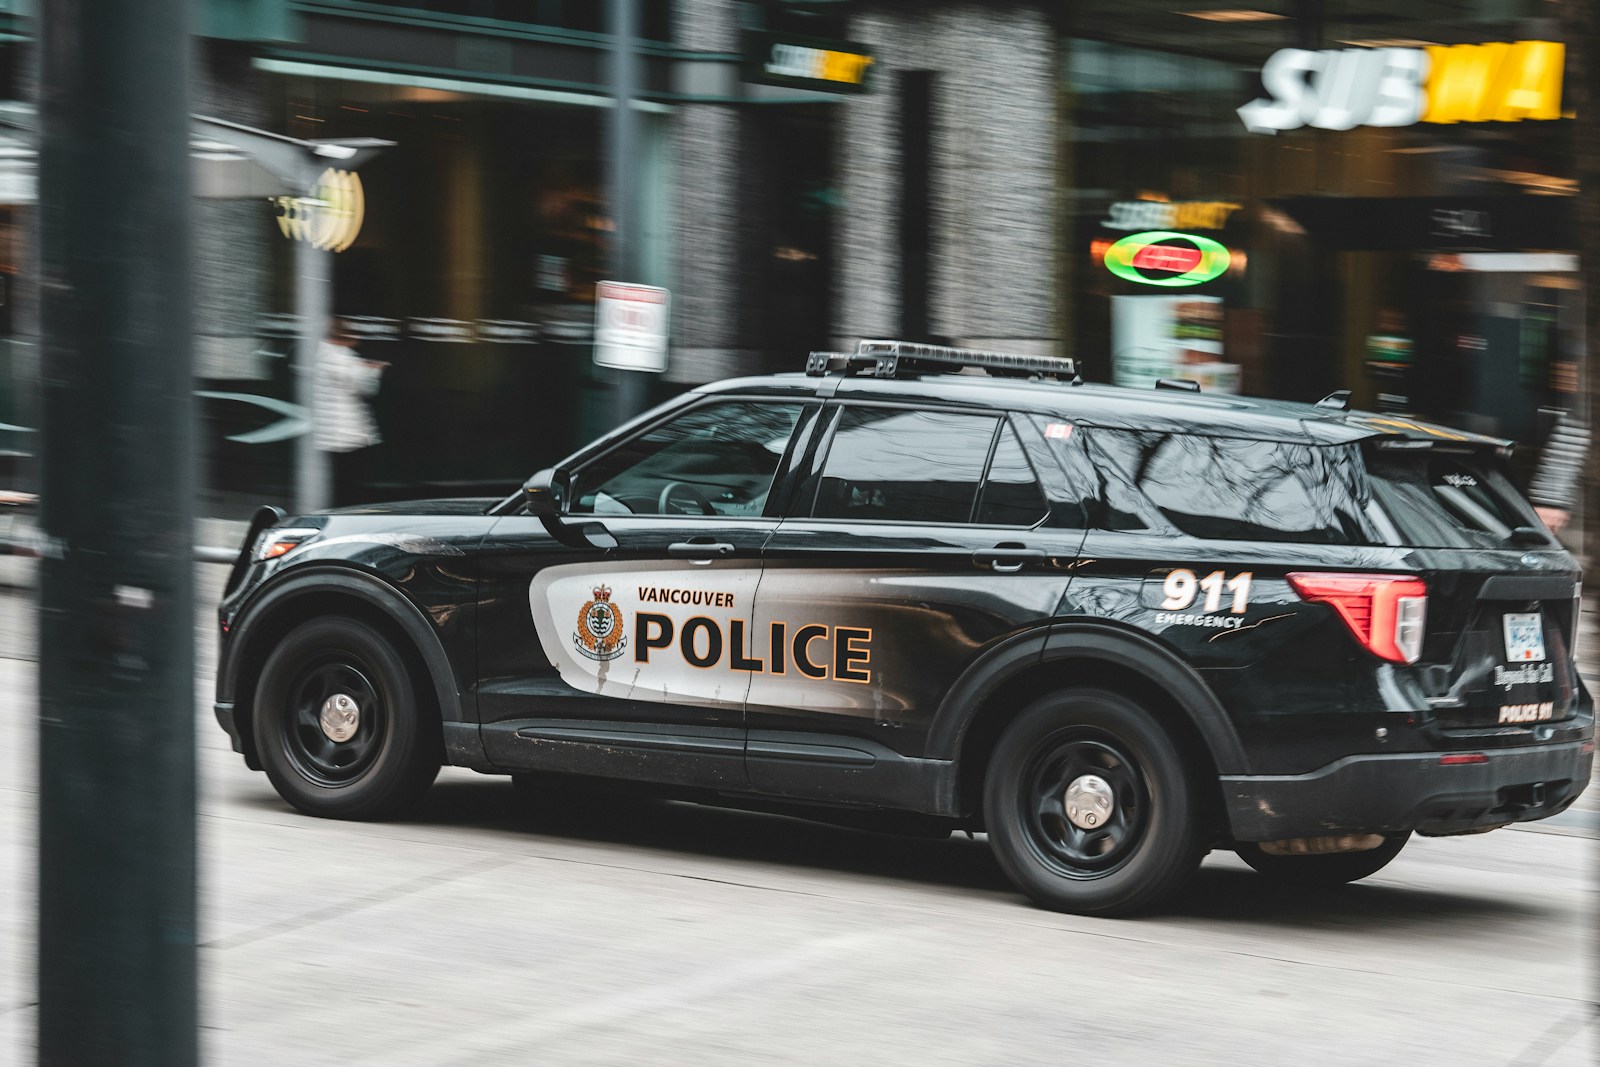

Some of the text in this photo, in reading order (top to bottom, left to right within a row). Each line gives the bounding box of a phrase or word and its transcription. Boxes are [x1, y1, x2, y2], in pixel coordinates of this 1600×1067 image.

[638, 586, 735, 608] VANCOUVER
[1160, 568, 1253, 614] 911
[1154, 613, 1245, 629] EMERGENCY
[634, 610, 873, 684] POLICE
[1498, 701, 1553, 723] POLICE 911
